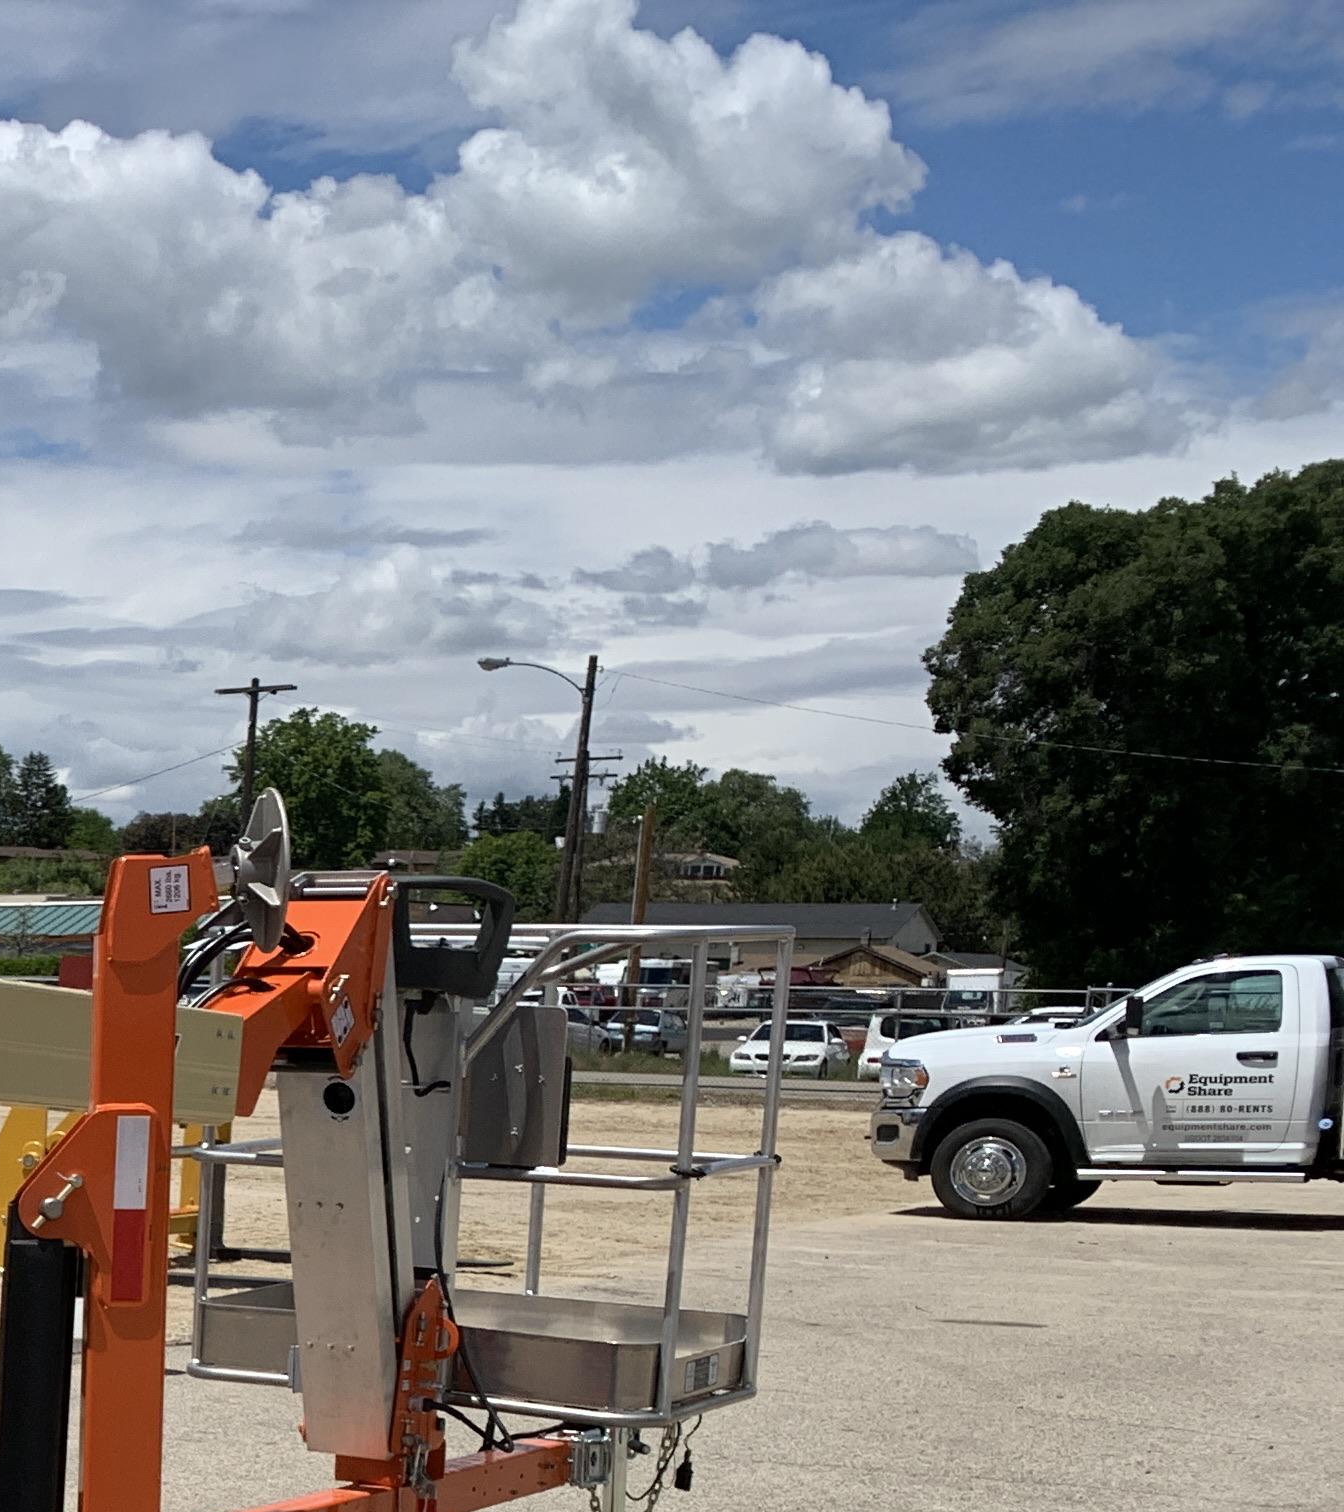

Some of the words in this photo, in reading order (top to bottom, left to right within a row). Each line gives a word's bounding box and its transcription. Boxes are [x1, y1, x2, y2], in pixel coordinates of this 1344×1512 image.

[1188, 1074, 1274, 1084] Equipment
[1187, 1087, 1233, 1096] Share
[1186, 1105, 1215, 1113] (888)
[1220, 1105, 1274, 1113] 80-RENTS
[1162, 1123, 1272, 1132] equipmentshare.com
